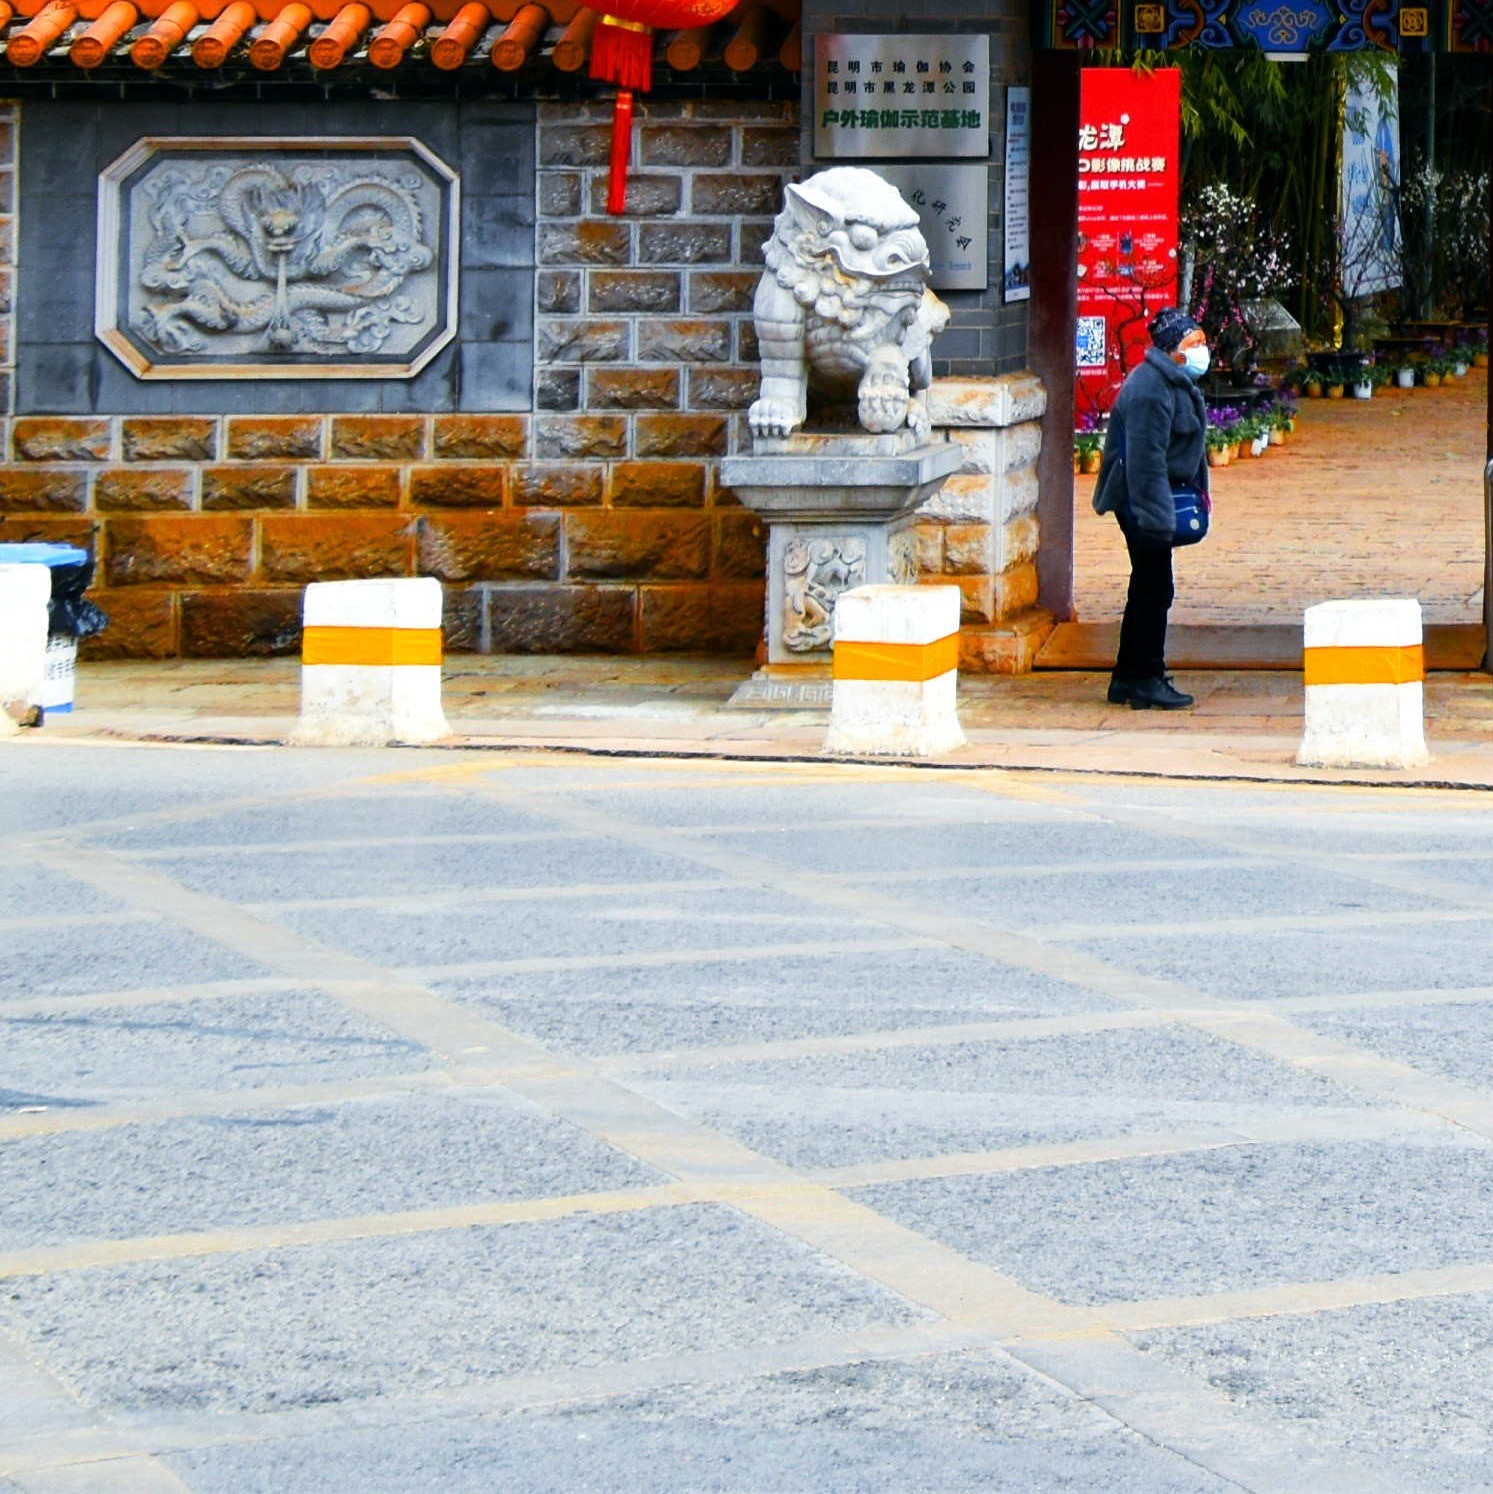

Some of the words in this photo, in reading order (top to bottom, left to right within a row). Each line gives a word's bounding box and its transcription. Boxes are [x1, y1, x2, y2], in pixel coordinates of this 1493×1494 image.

[827, 60, 975, 74] 昆明市瑜伽协会
[827, 81, 976, 95] 昆明市黑龙潭公园
[821, 109, 981, 130] 户外瑜伽示范基地
